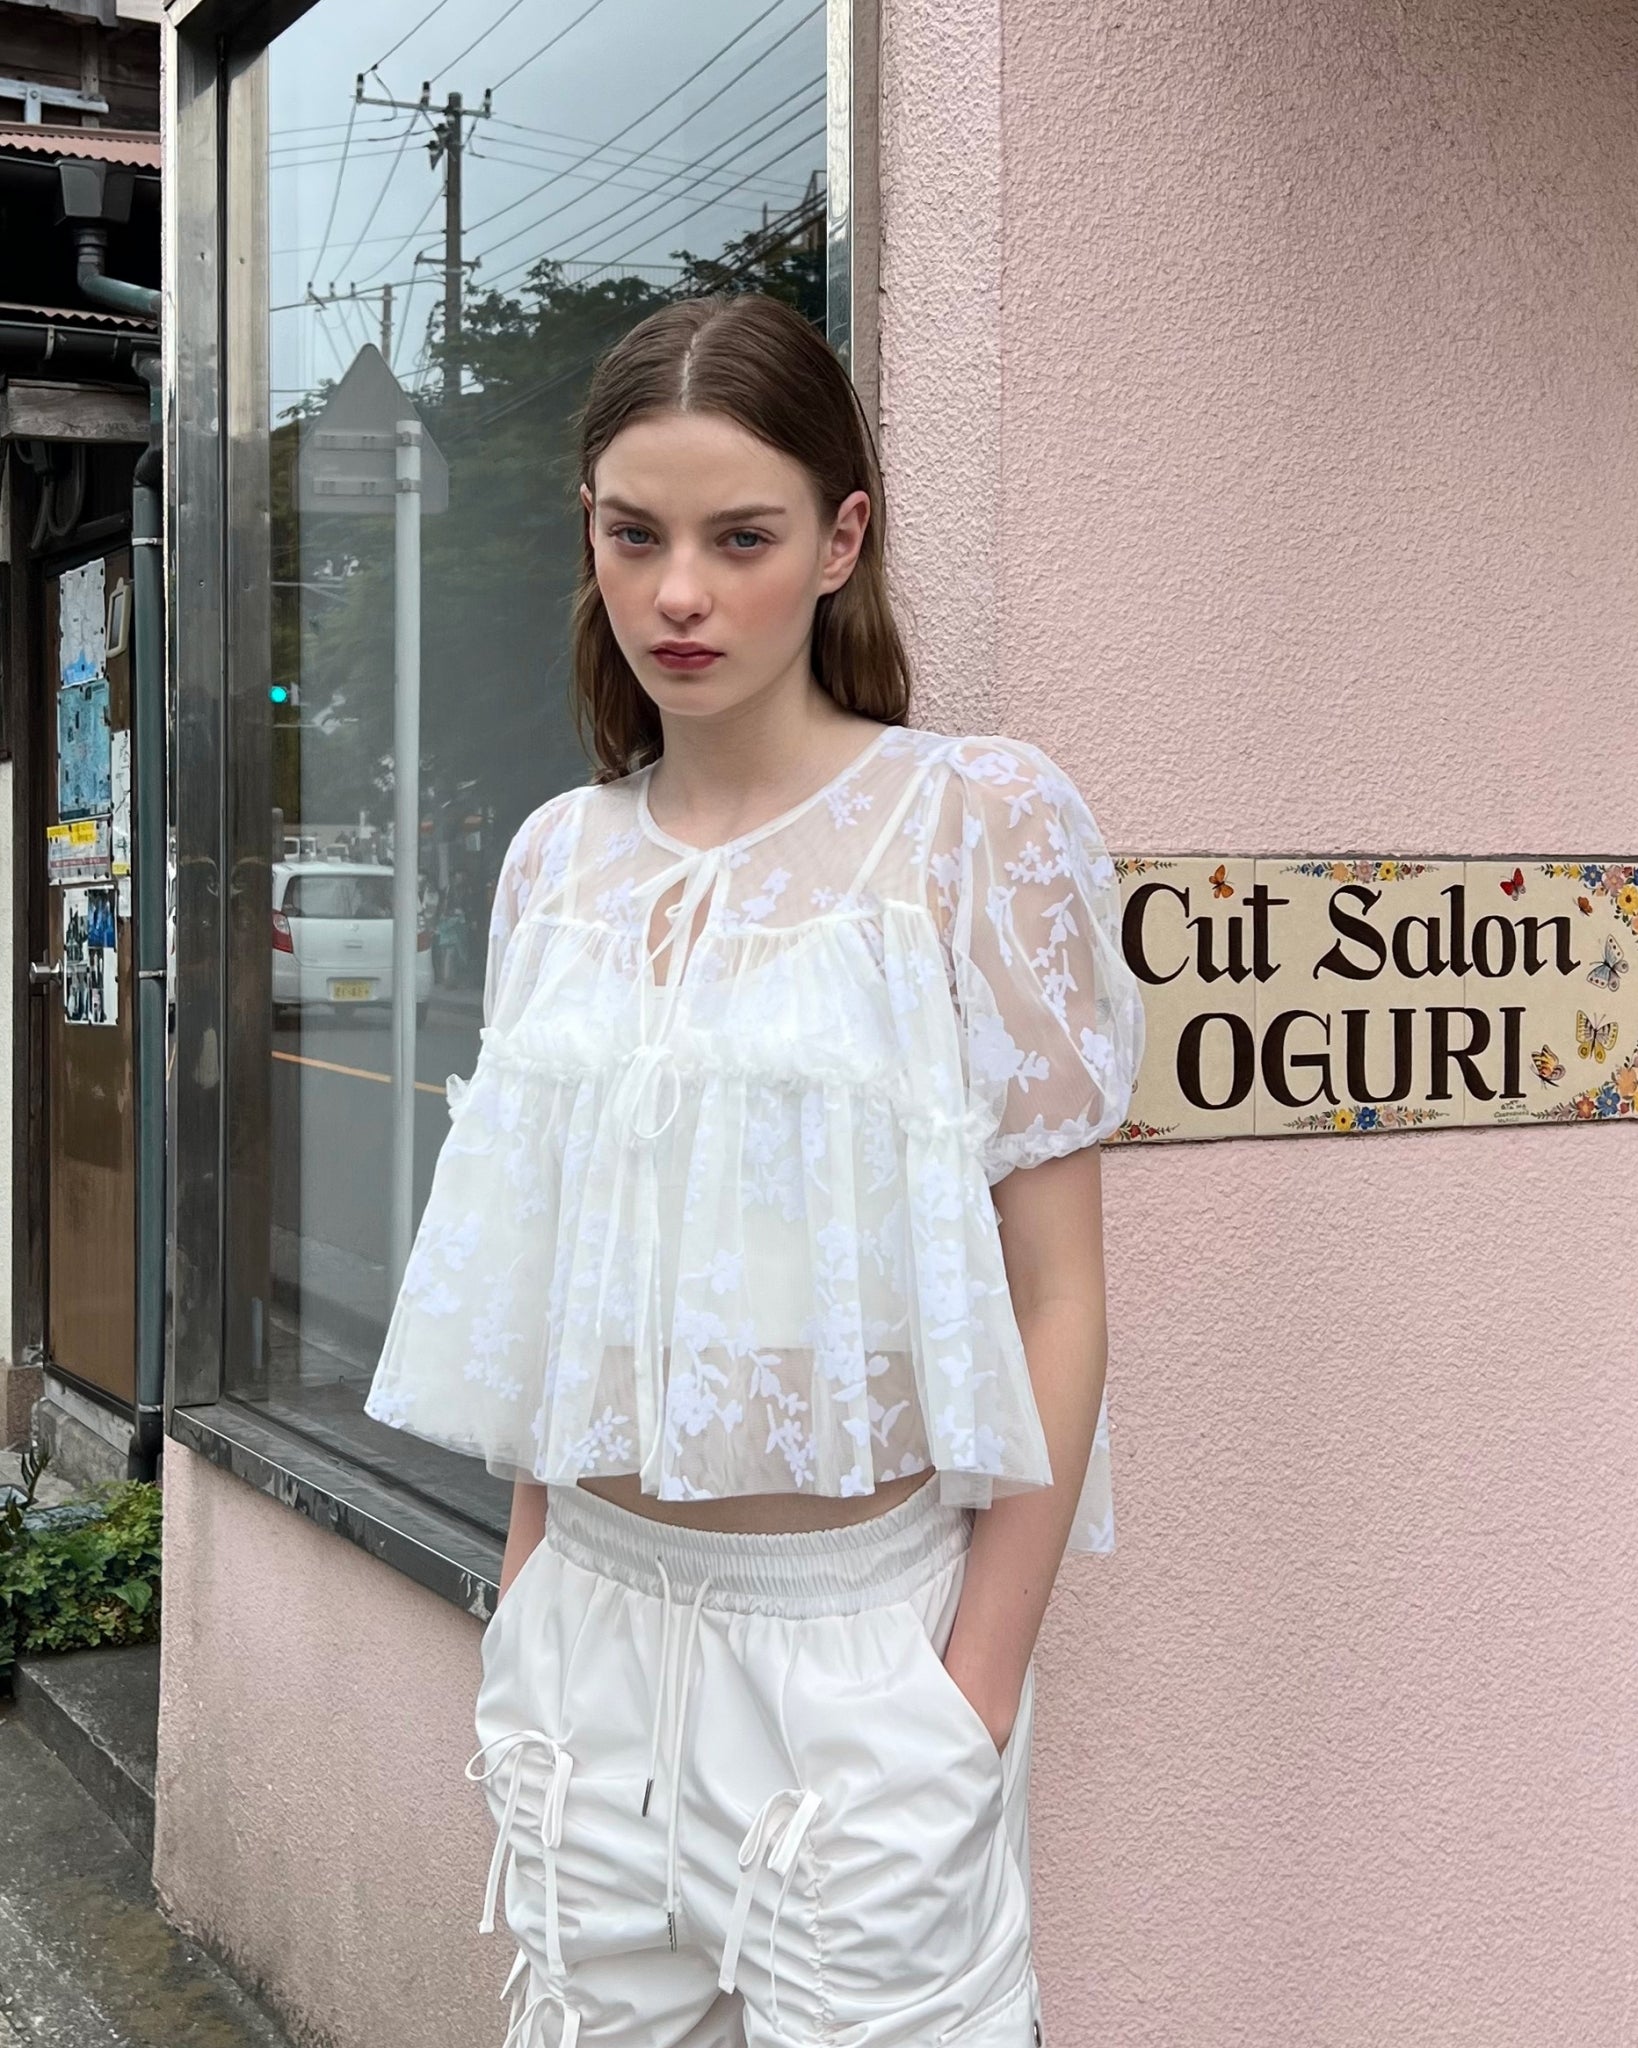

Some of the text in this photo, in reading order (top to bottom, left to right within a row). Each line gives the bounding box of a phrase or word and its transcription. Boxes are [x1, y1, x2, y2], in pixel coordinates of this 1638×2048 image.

[1121, 882, 1581, 985] Cut Salon
[1176, 1006, 1527, 1110] OGURI
